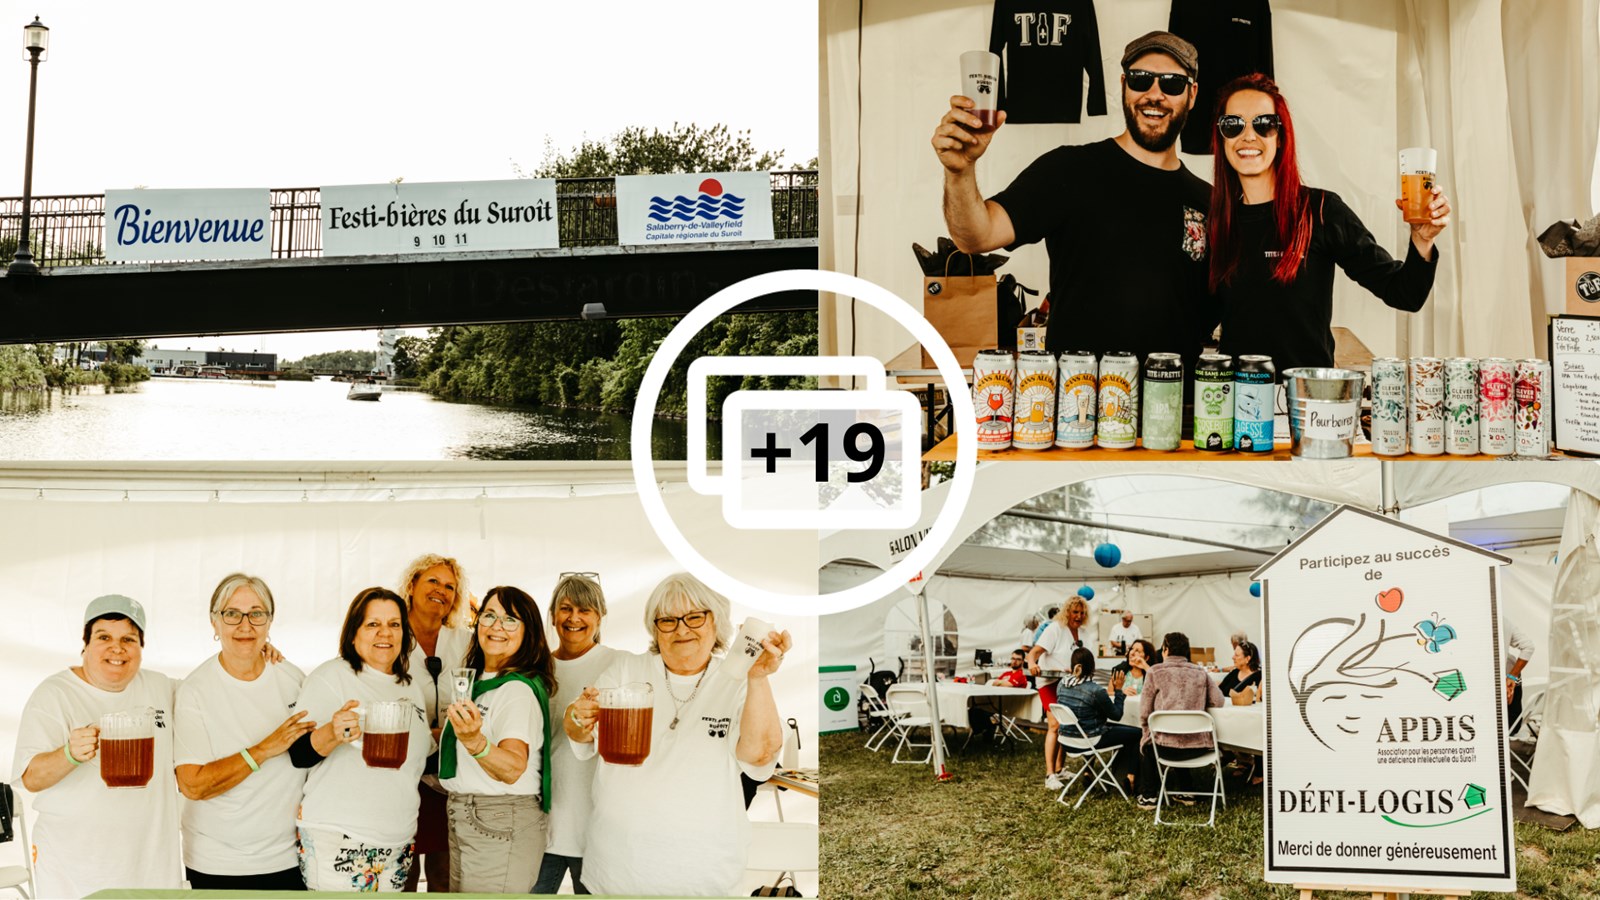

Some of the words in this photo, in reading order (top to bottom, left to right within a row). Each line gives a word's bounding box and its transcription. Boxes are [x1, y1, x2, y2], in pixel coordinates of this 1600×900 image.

[114, 204, 264, 246] Bienvenue
[329, 201, 447, 230] Festi-bières
[454, 199, 482, 225] du
[487, 198, 554, 224] Suroît
[646, 220, 743, 232] Salaberry-de-Valleyfield
[646, 233, 675, 241] Capitale
[676, 230, 709, 240] régionale
[710, 230, 719, 238] du
[414, 236, 421, 247] 9
[433, 234, 445, 246] 10
[455, 233, 468, 245] 11
[889, 533, 918, 556] SALON
[1299, 555, 1371, 571] Participez
[1374, 553, 1393, 563] au
[1395, 545, 1451, 561] succès
[1364, 569, 1383, 581] de
[1376, 714, 1477, 743] APDIS
[1278, 782, 1454, 814] DÉFI-LOGIS
[1278, 840, 1313, 856] Merci
[1316, 841, 1332, 856] de
[1336, 842, 1382, 858] donner
[1386, 842, 1497, 861] généreusement
